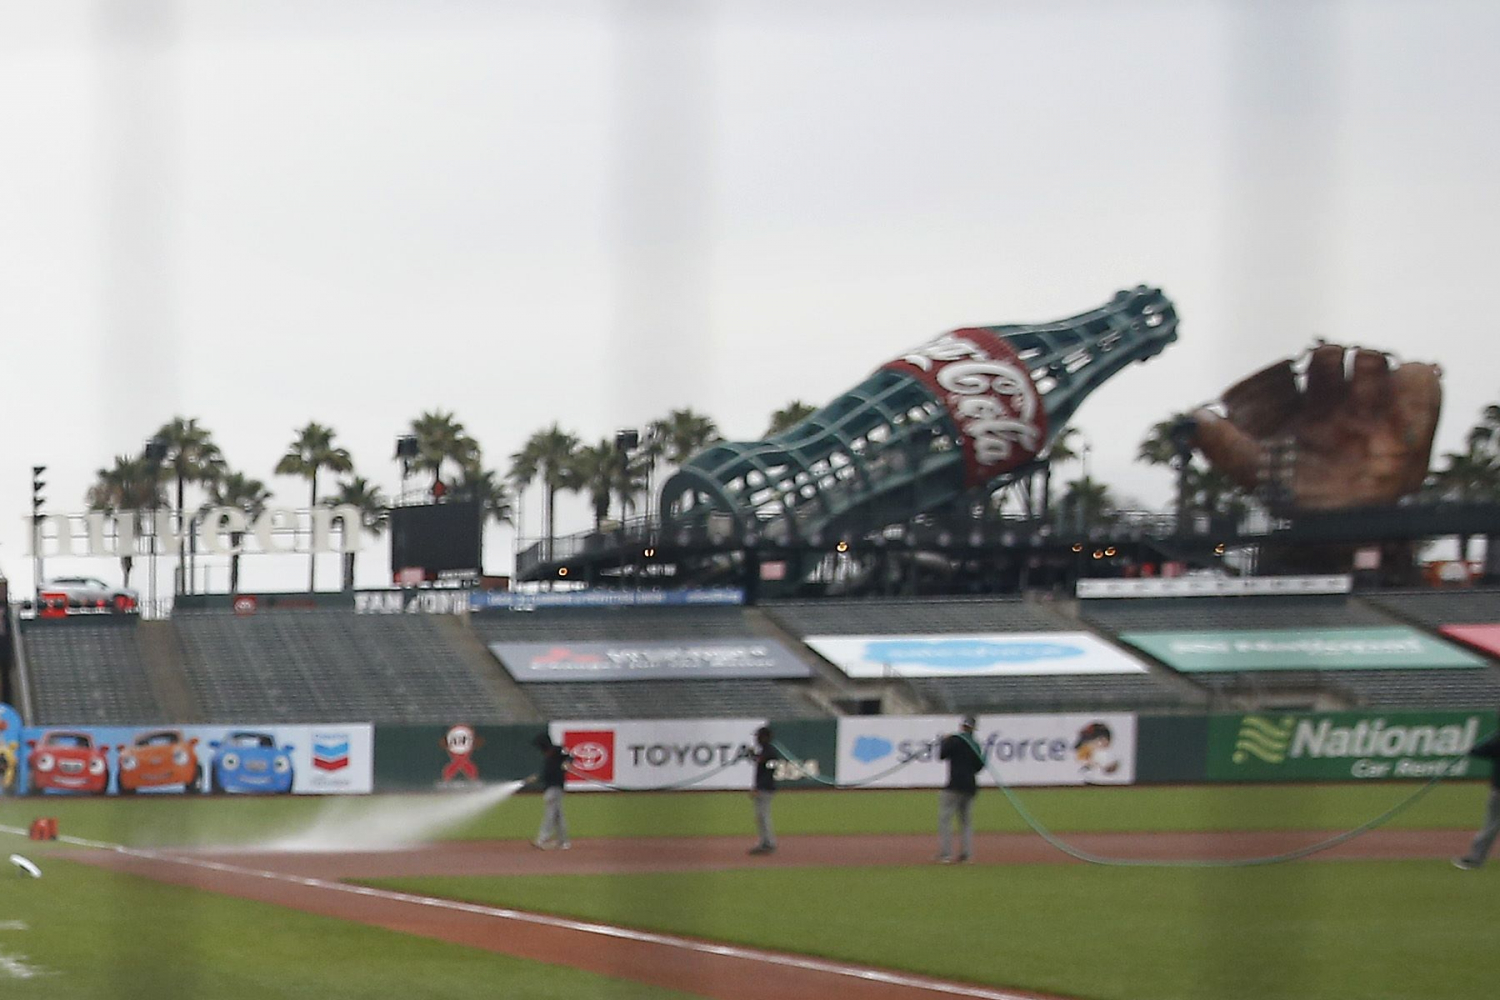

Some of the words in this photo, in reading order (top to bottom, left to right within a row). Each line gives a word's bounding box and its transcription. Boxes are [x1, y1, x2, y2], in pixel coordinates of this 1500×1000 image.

[1290, 716, 1480, 759] National
[628, 743, 759, 768] TOYOTA
[1350, 759, 1391, 778] Car
[1393, 758, 1470, 778] Rental
